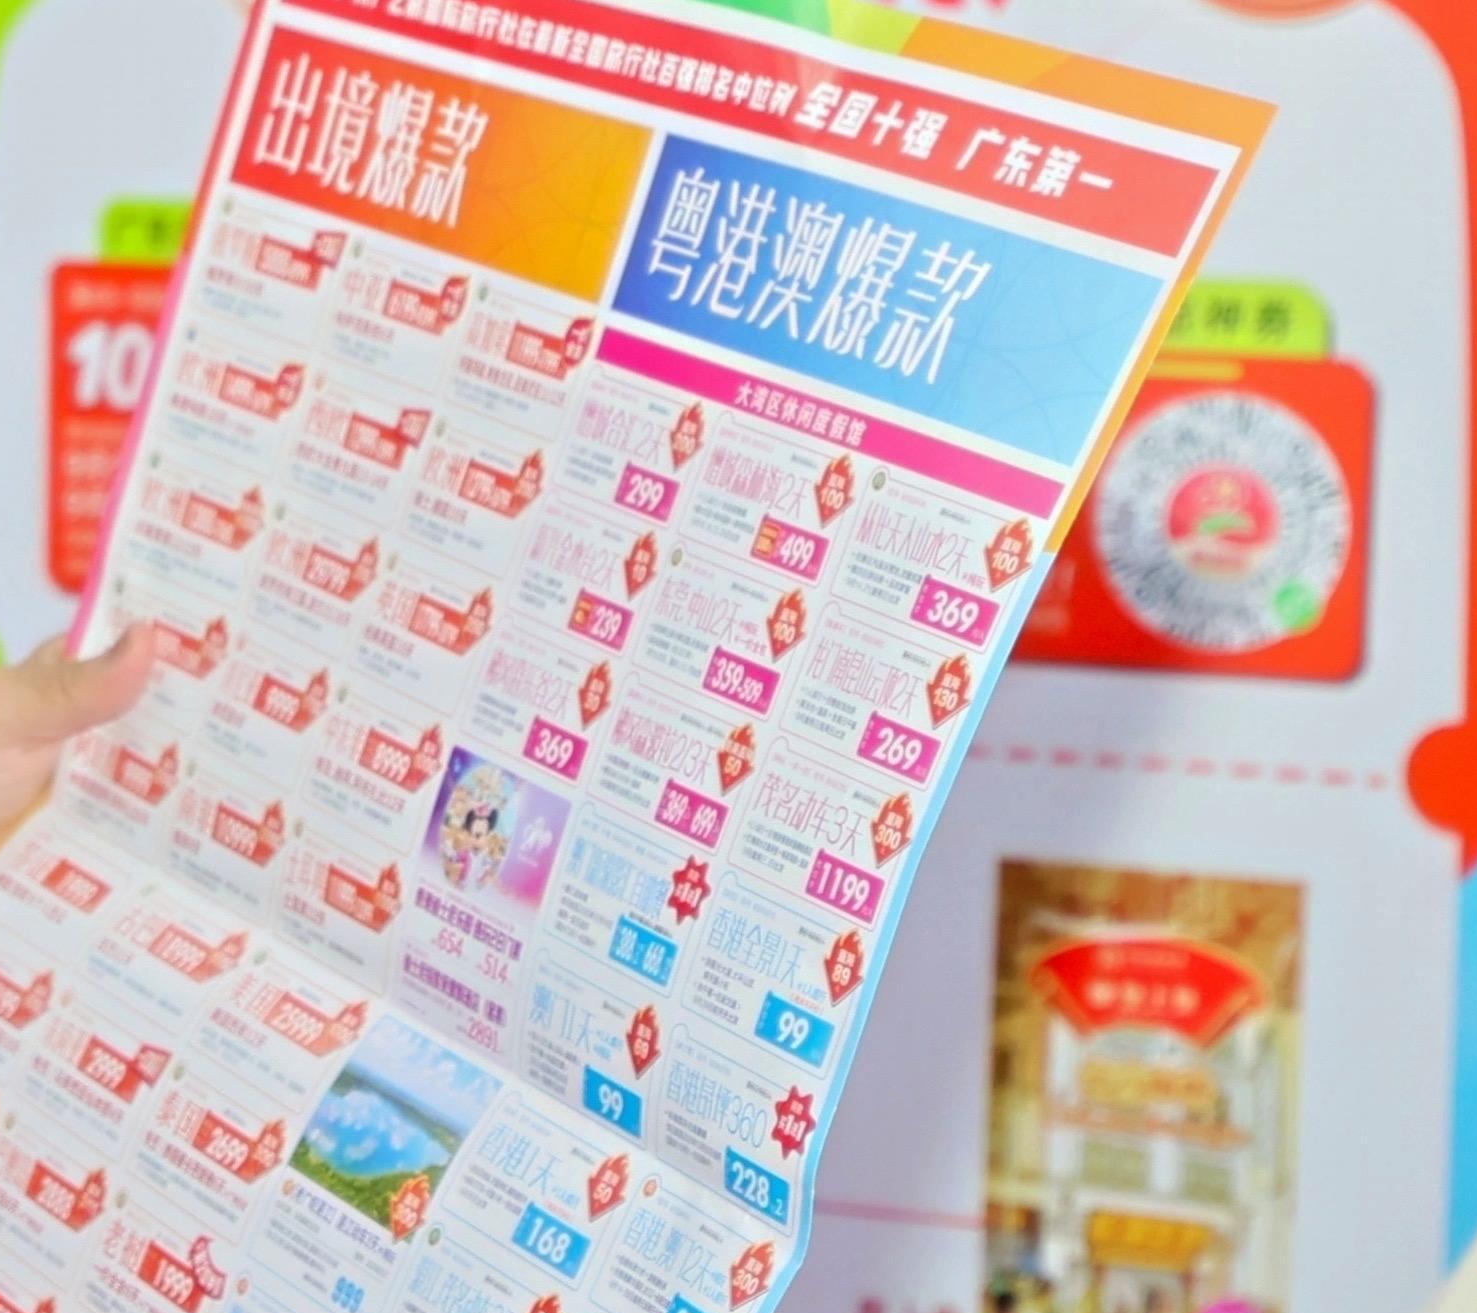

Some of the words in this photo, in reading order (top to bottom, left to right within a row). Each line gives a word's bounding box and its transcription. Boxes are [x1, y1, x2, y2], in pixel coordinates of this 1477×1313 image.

[246, 47, 496, 229] 出境爆款
[791, 77, 949, 162] 全国十强
[954, 122, 1121, 210] 广东第一
[633, 161, 996, 387] 粤港澳爆款
[732, 380, 868, 448] 大湾区休闲度假馆
[622, 473, 667, 514] 299
[816, 485, 846, 511] 100
[774, 530, 819, 573] 499
[989, 549, 1020, 574] 100
[588, 604, 625, 643] 239
[924, 588, 983, 637] 369
[710, 654, 768, 706] 359-509
[931, 685, 960, 709] 130
[531, 727, 577, 771] 369
[721, 753, 744, 778] 50
[869, 725, 925, 772] 269
[752, 770, 871, 857] 茂名动车3天
[873, 824, 903, 850] 300
[813, 862, 873, 914] 1199
[703, 905, 811, 989] 香港全景1天
[829, 962, 854, 987] 89
[771, 1008, 813, 1052] 99
[591, 1082, 629, 1122] 99
[473, 1118, 565, 1196] 香港1天
[724, 1159, 777, 1209] 228
[521, 1216, 575, 1266] 168
[731, 1268, 761, 1294] 300
